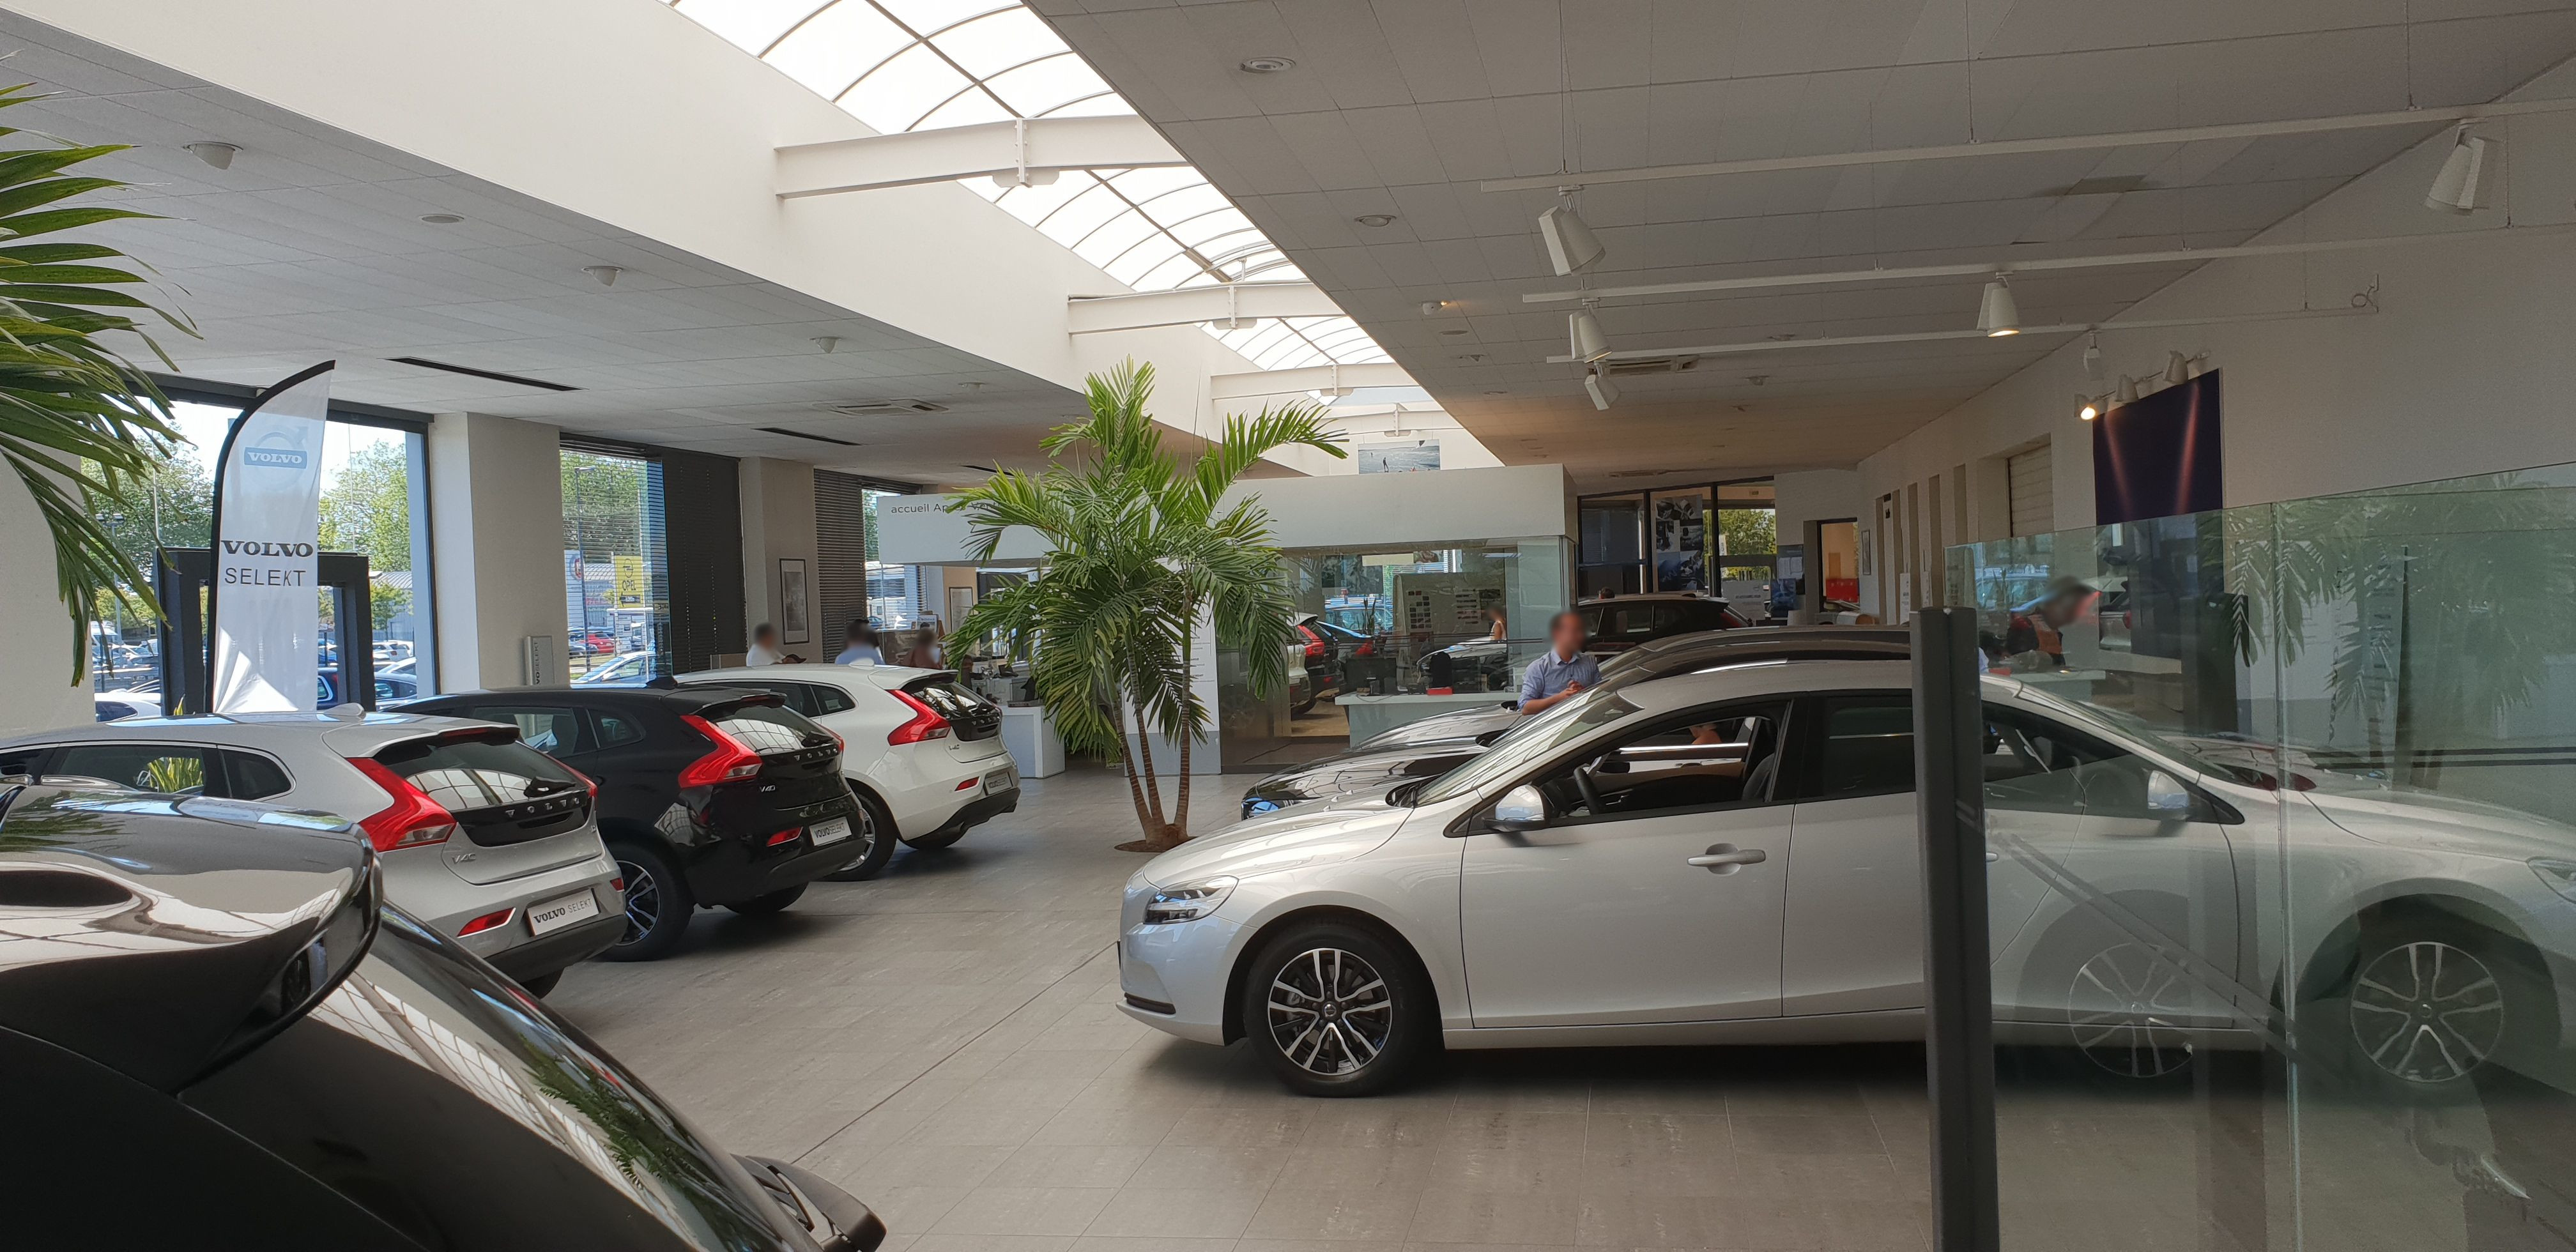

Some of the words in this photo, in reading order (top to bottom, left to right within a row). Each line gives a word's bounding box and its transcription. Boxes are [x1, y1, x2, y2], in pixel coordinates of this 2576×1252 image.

[247, 452, 302, 464] VOLVO
[891, 503, 929, 514] accueil
[221, 540, 313, 557] VOLVO
[225, 568, 306, 586] SELEKT
[622, 580, 636, 591] OPEL
[793, 748, 838, 761] VOLVO
[505, 798, 580, 818] VOLVO
[814, 827, 829, 838] VOLVO
[533, 908, 565, 923] VOLVO
[568, 899, 591, 913] SELEKT
